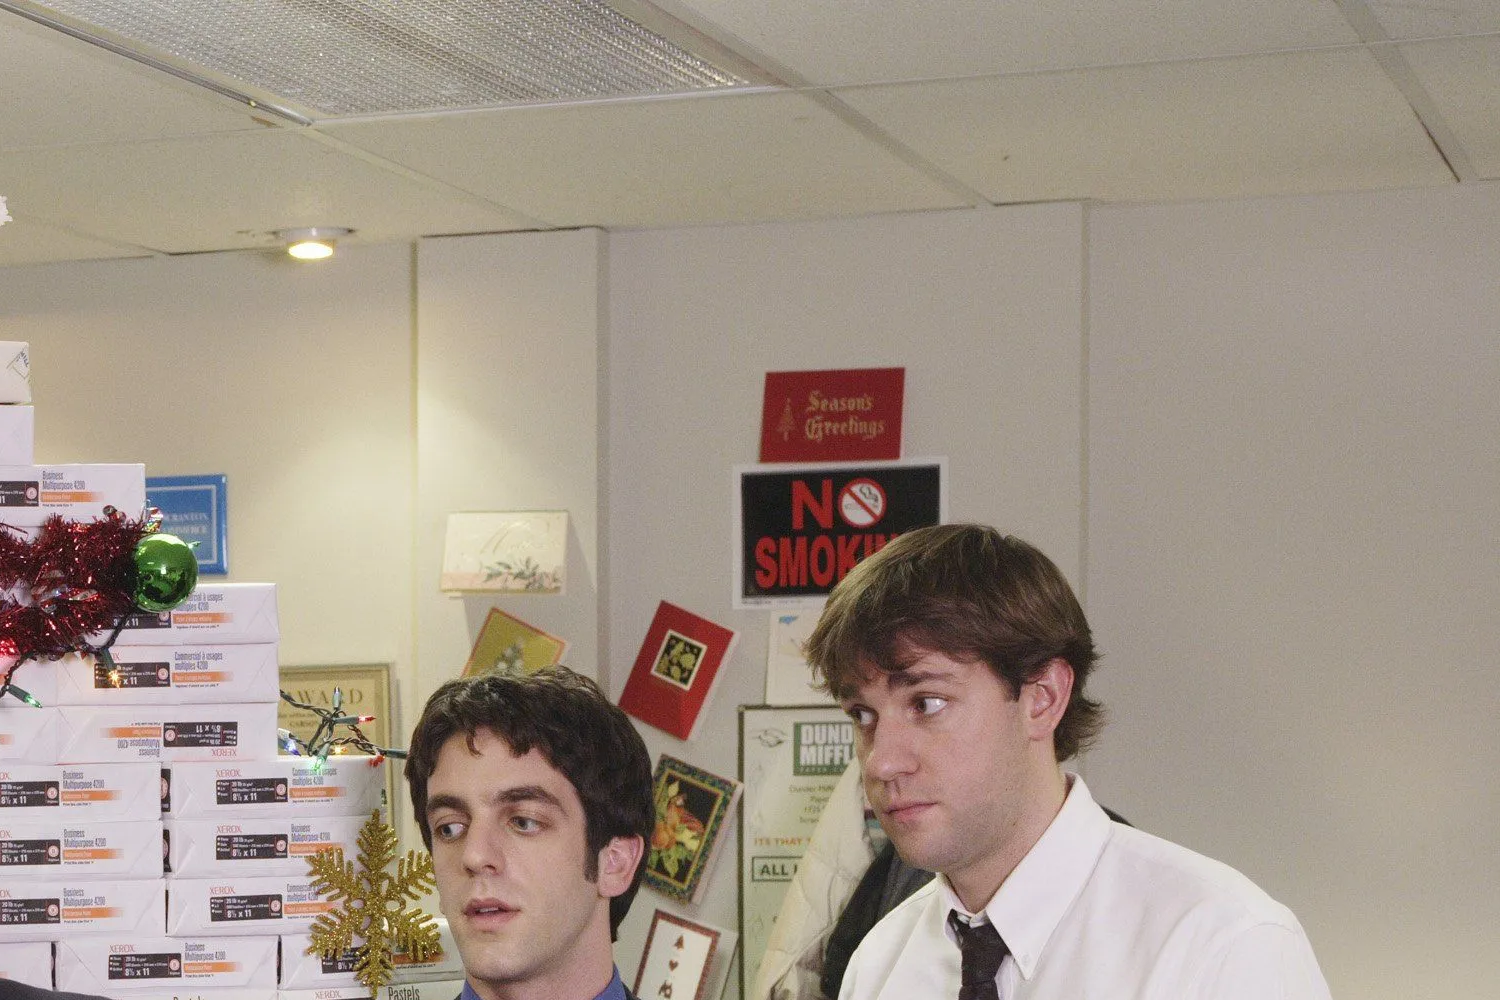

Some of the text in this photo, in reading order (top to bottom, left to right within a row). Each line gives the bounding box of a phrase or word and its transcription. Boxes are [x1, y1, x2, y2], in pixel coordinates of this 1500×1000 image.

[805, 416, 886, 442] Greetings
[42, 471, 63, 480] Business
[42, 481, 85, 490] Multipurpose 4200
[0, 496, 5, 504] 11
[198, 602, 209, 611] 4200
[131, 618, 139, 627] 11
[197, 661, 208, 670] 4200
[130, 677, 137, 685] 11
[196, 725, 203, 733] 11
[801, 724, 854, 745] DUND
[212, 749, 237, 757] XEROX
[800, 745, 853, 766] MIFFL
[63, 771, 83, 779] Business
[216, 769, 242, 777] XEROX
[63, 779, 104, 789] Multipurpose 4200
[313, 776, 324, 785] 4200
[20, 796, 27, 804] 11
[250, 792, 257, 800] 11
[216, 825, 242, 833] XEROX
[291, 824, 310, 832] Business
[64, 829, 85, 838] Business
[320, 832, 330, 841] 4200
[64, 838, 106, 848] Multipurpose 4200
[20, 854, 28, 862] 11
[760, 864, 788, 876] ALL
[63, 888, 84, 897] Business
[210, 886, 236, 894] XEROX
[63, 896, 106, 906] Multipurpose 4200
[245, 909, 252, 917] 11
[20, 914, 28, 922] 11
[109, 944, 135, 952] XEROX
[185, 943, 205, 951] Business
[185, 951, 226, 961] Multipurpose 4200
[142, 968, 150, 976] 11
[315, 991, 341, 999] XEROX
